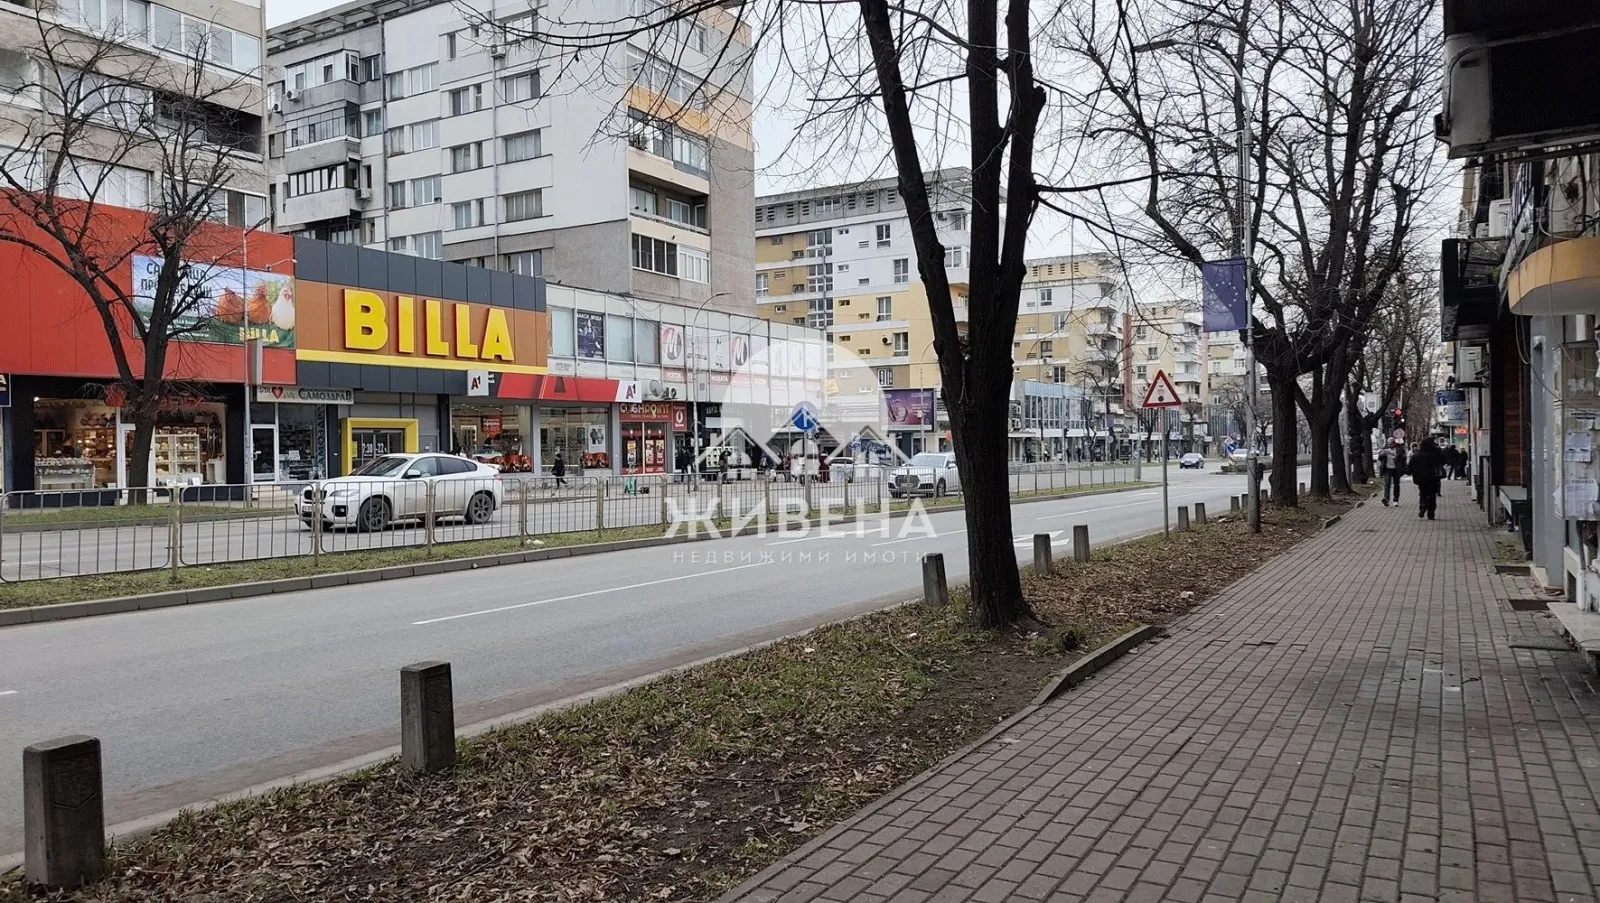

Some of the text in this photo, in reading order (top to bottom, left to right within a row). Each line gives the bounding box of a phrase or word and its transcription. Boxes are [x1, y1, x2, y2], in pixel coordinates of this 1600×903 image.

[344, 289, 515, 361] BILLA
[239, 327, 279, 343] BILLA
[471, 376, 481, 390] A1
[626, 384, 636, 399] A1
